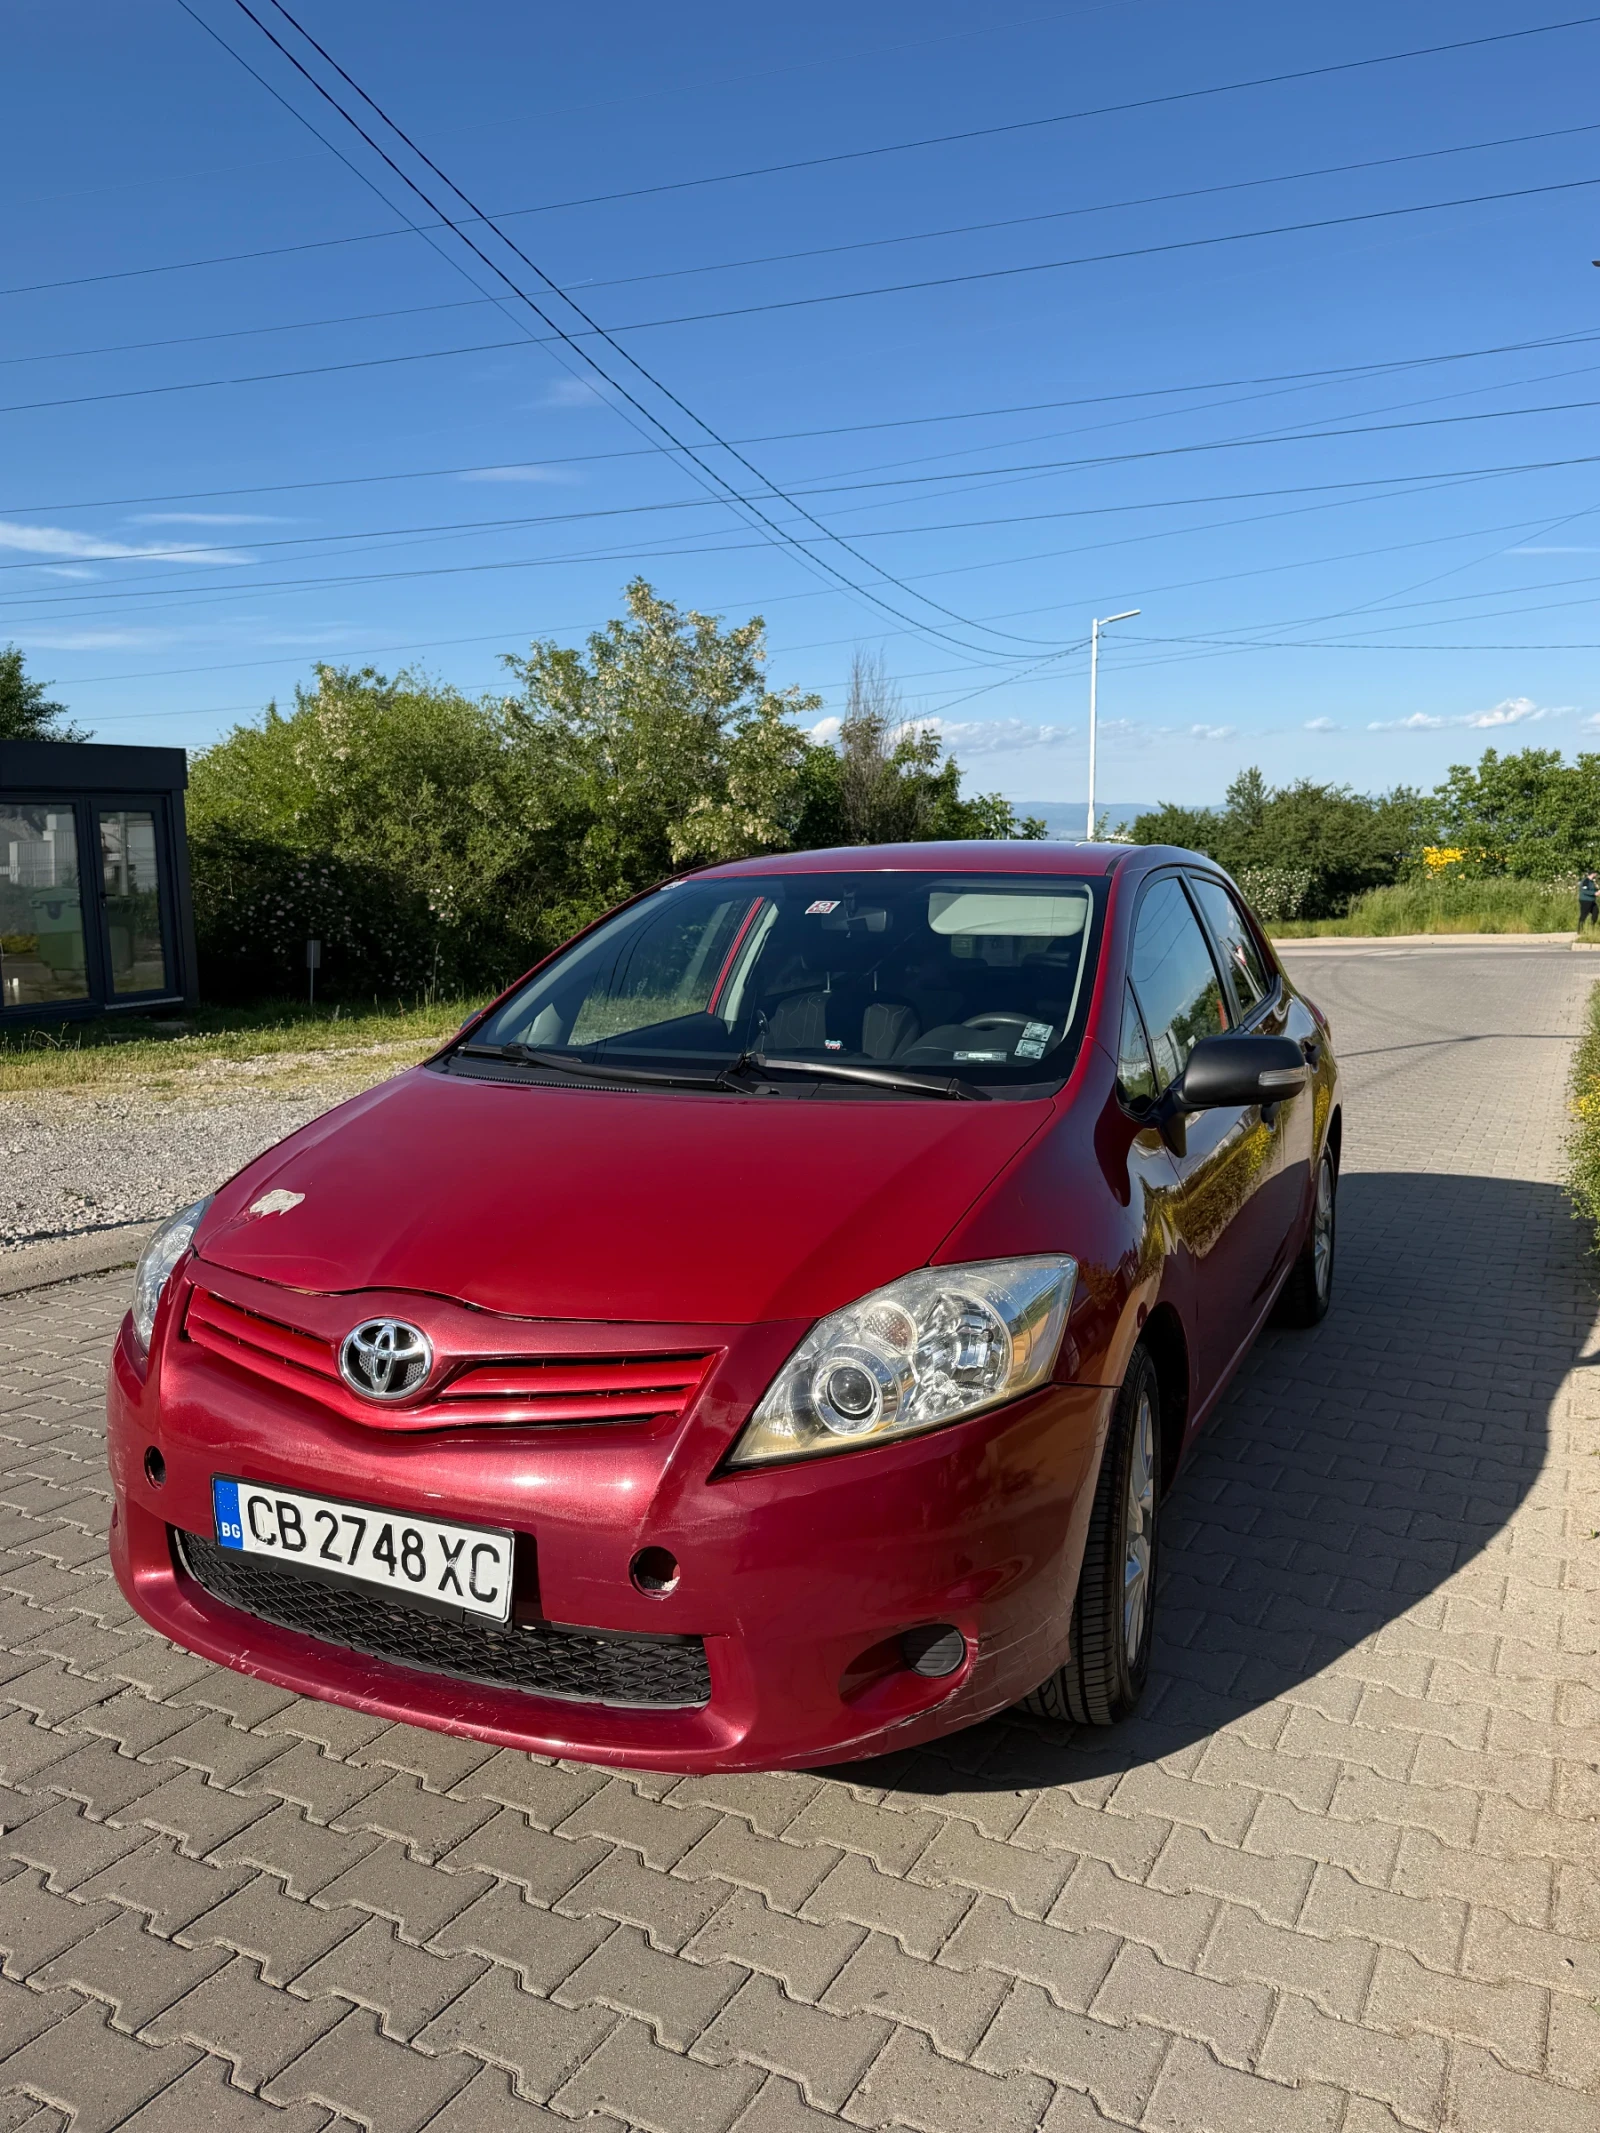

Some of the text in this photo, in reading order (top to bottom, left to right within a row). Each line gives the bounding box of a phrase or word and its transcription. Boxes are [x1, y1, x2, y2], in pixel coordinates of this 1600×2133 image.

[221, 1521, 241, 1539] BG
[247, 1495, 500, 1603] CB 2748 XC
